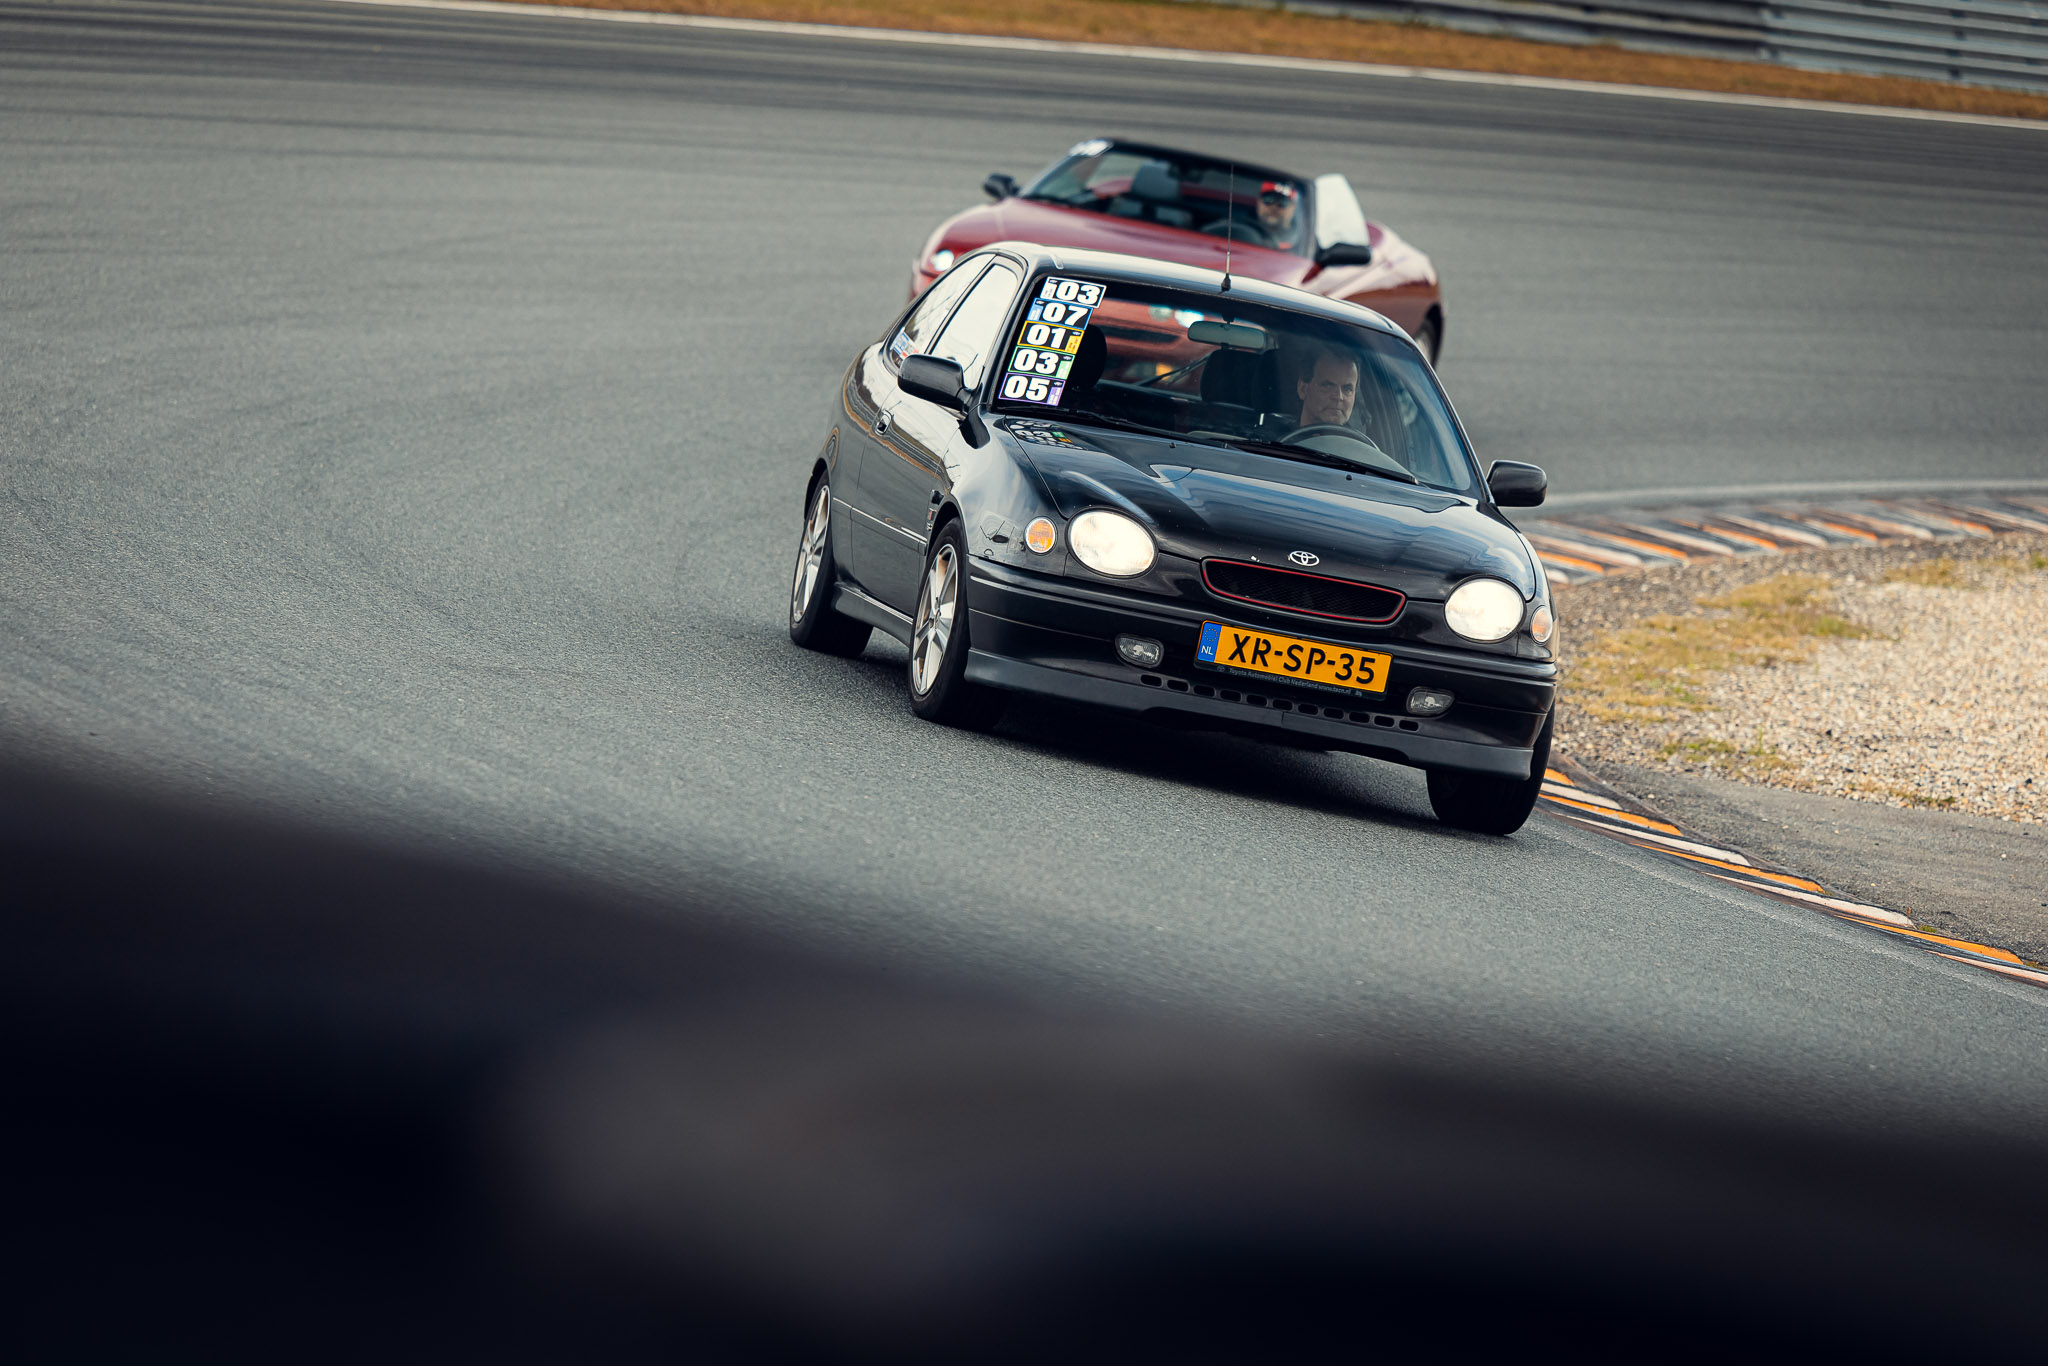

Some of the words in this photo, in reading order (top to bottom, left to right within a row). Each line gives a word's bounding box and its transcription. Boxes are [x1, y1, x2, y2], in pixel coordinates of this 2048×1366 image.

[1055, 281, 1101, 305] 03
[1042, 302, 1088, 326] 07
[1026, 324, 1066, 349] 01
[1013, 349, 1059, 374] 03
[1004, 375, 1050, 401] 05
[1201, 645, 1213, 656] NL
[1228, 633, 1376, 684] XR-SP-35
[1229, 667, 1247, 677] Toyota
[1278, 675, 1290, 684] Club
[1291, 679, 1318, 689] Nederland
